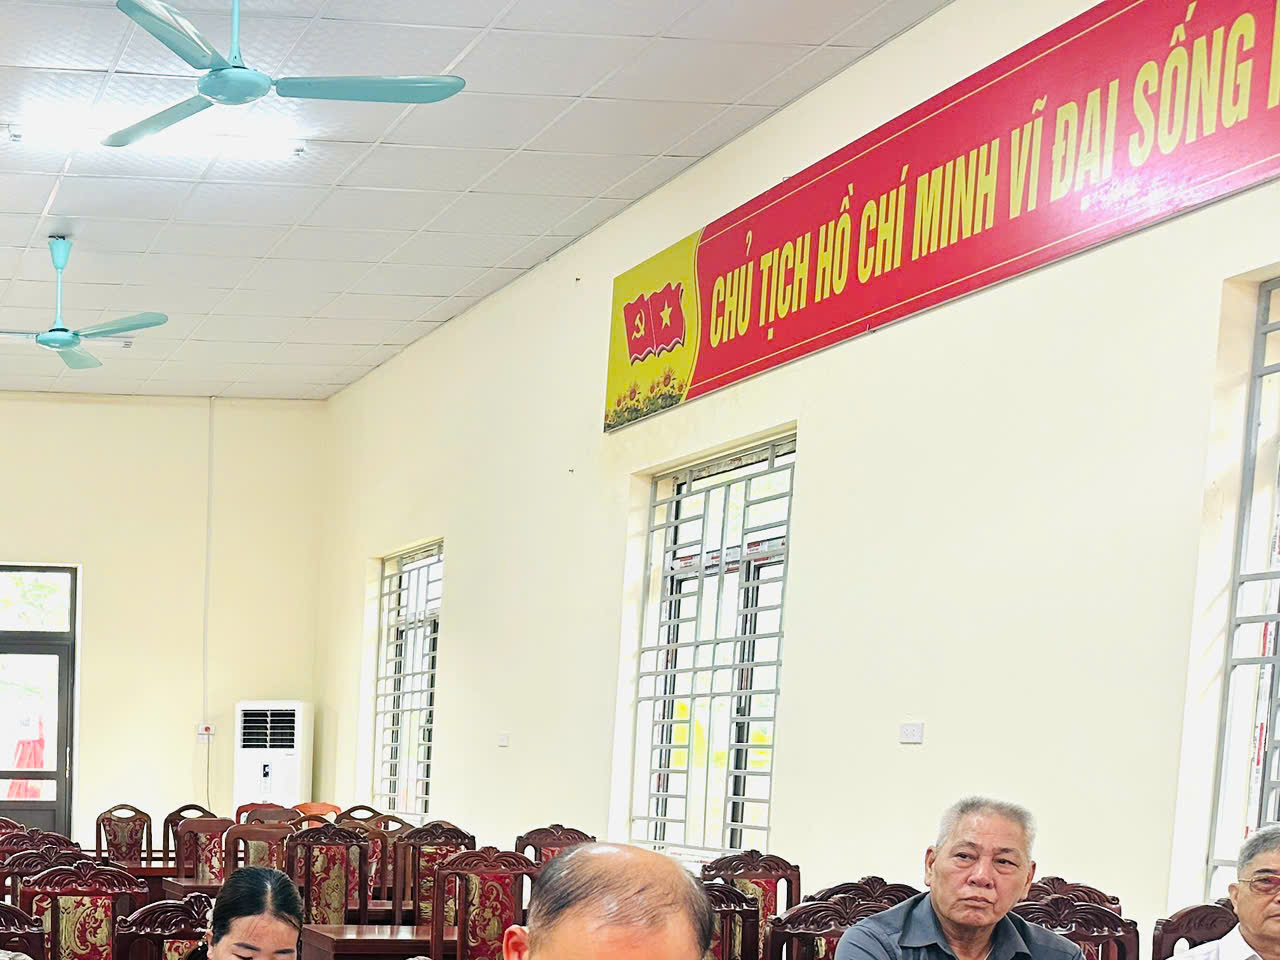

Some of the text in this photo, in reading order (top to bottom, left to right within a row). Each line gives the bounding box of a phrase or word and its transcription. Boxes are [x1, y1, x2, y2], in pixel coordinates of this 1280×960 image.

[710, 230, 754, 348] CHỦ
[759, 231, 811, 341] TỊCH
[814, 183, 854, 303] HỒ
[857, 164, 909, 284] CHÍ
[911, 137, 1000, 262] MINH
[1009, 94, 1047, 220] VĨ
[1050, 78, 1119, 212] ĐẠI
[1128, 0, 1256, 168] SỐNG
